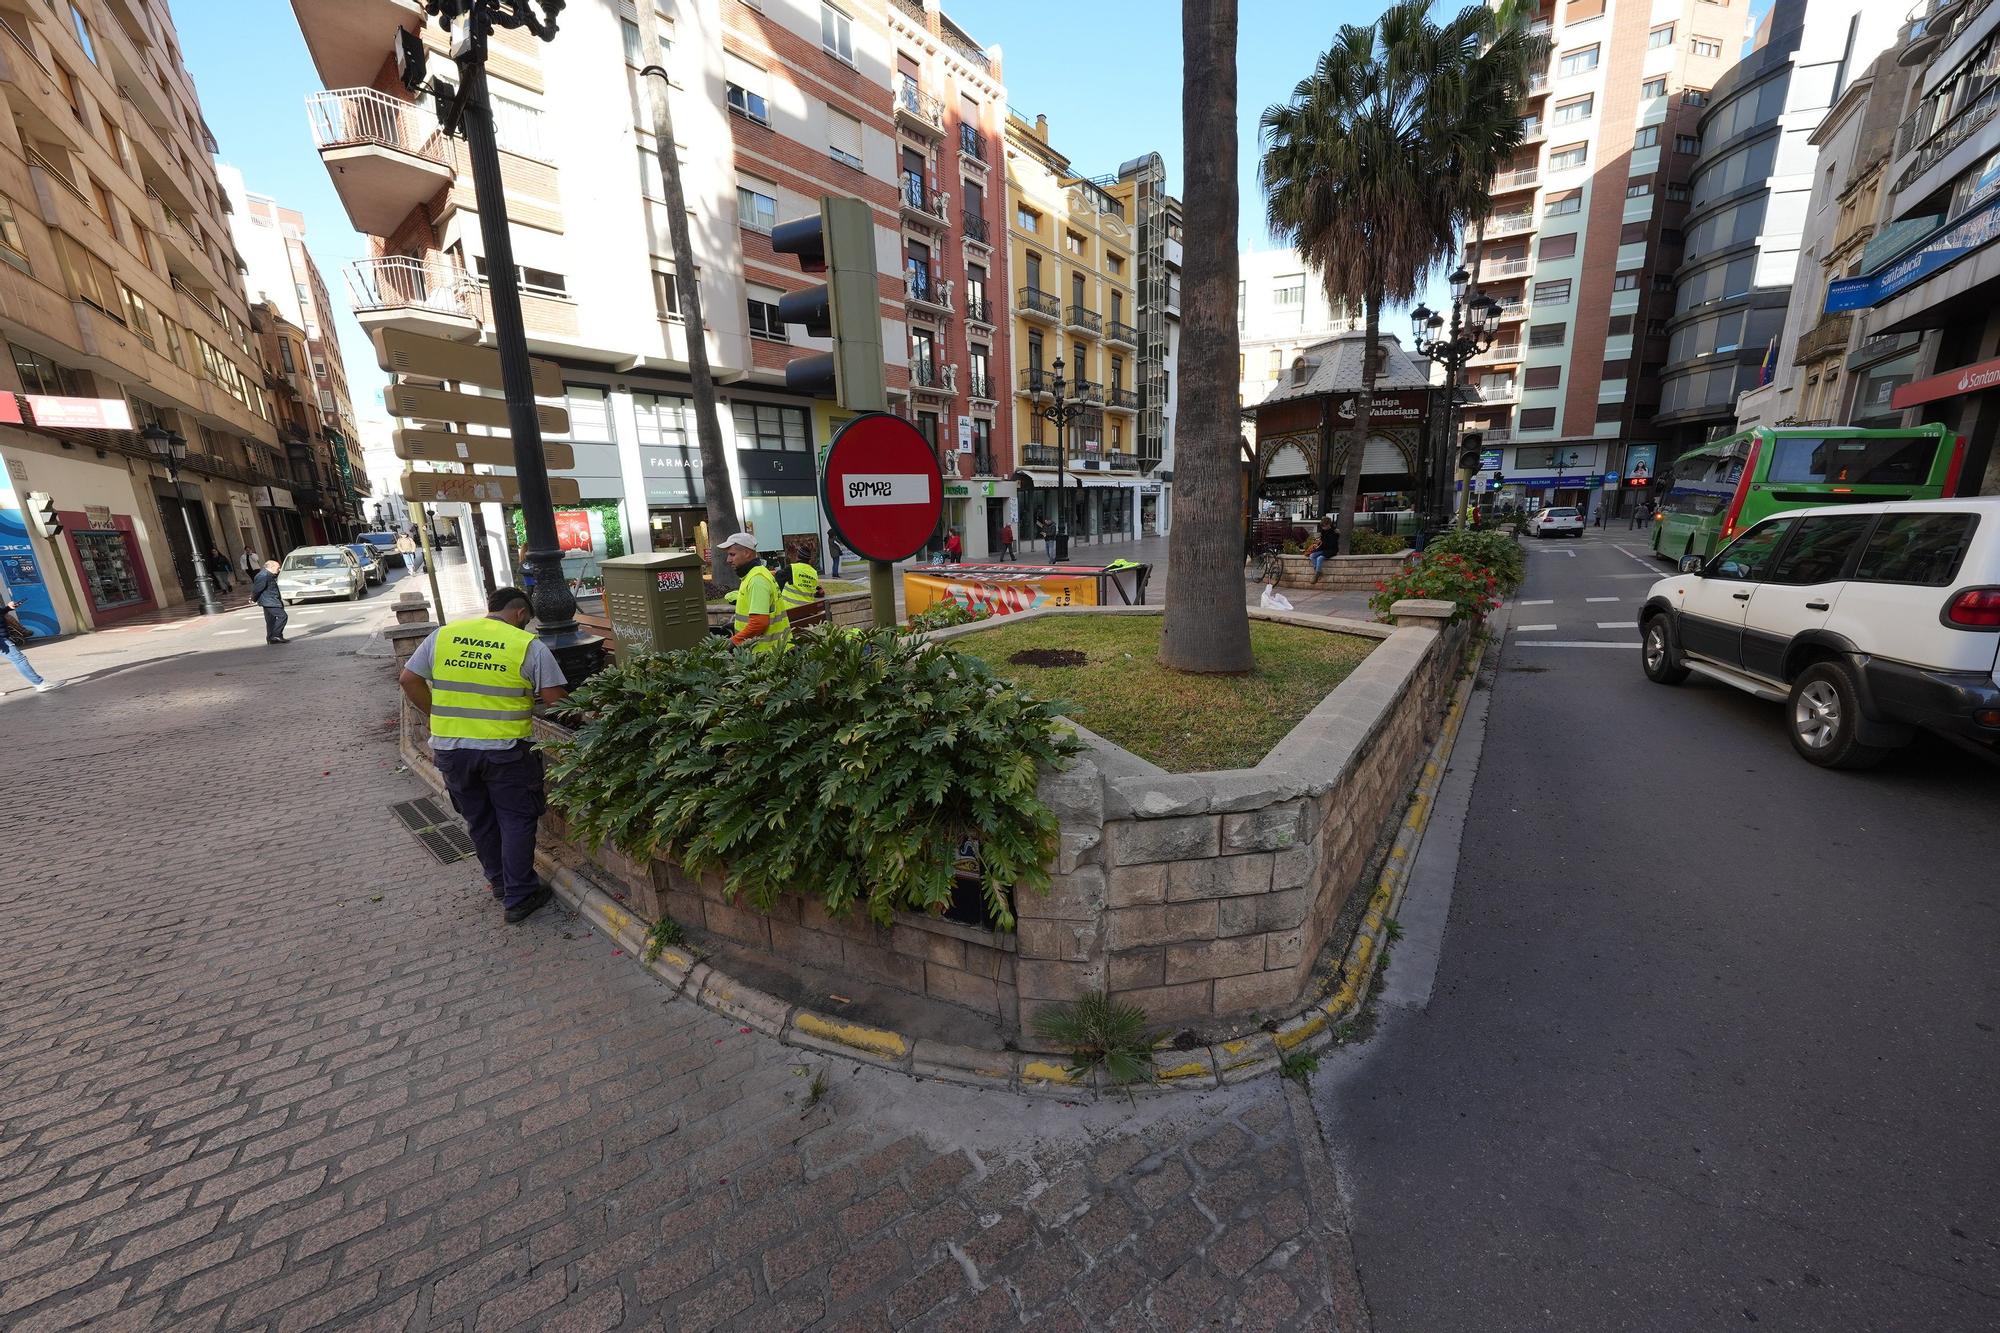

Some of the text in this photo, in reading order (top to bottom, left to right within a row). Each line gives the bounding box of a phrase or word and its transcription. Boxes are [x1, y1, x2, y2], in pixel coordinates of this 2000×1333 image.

[1369, 407, 1420, 416] Valenciana
[453, 636, 506, 650] PAVASAL
[460, 650, 492, 661] ZERO
[444, 658, 507, 673] ACCIDENTS
